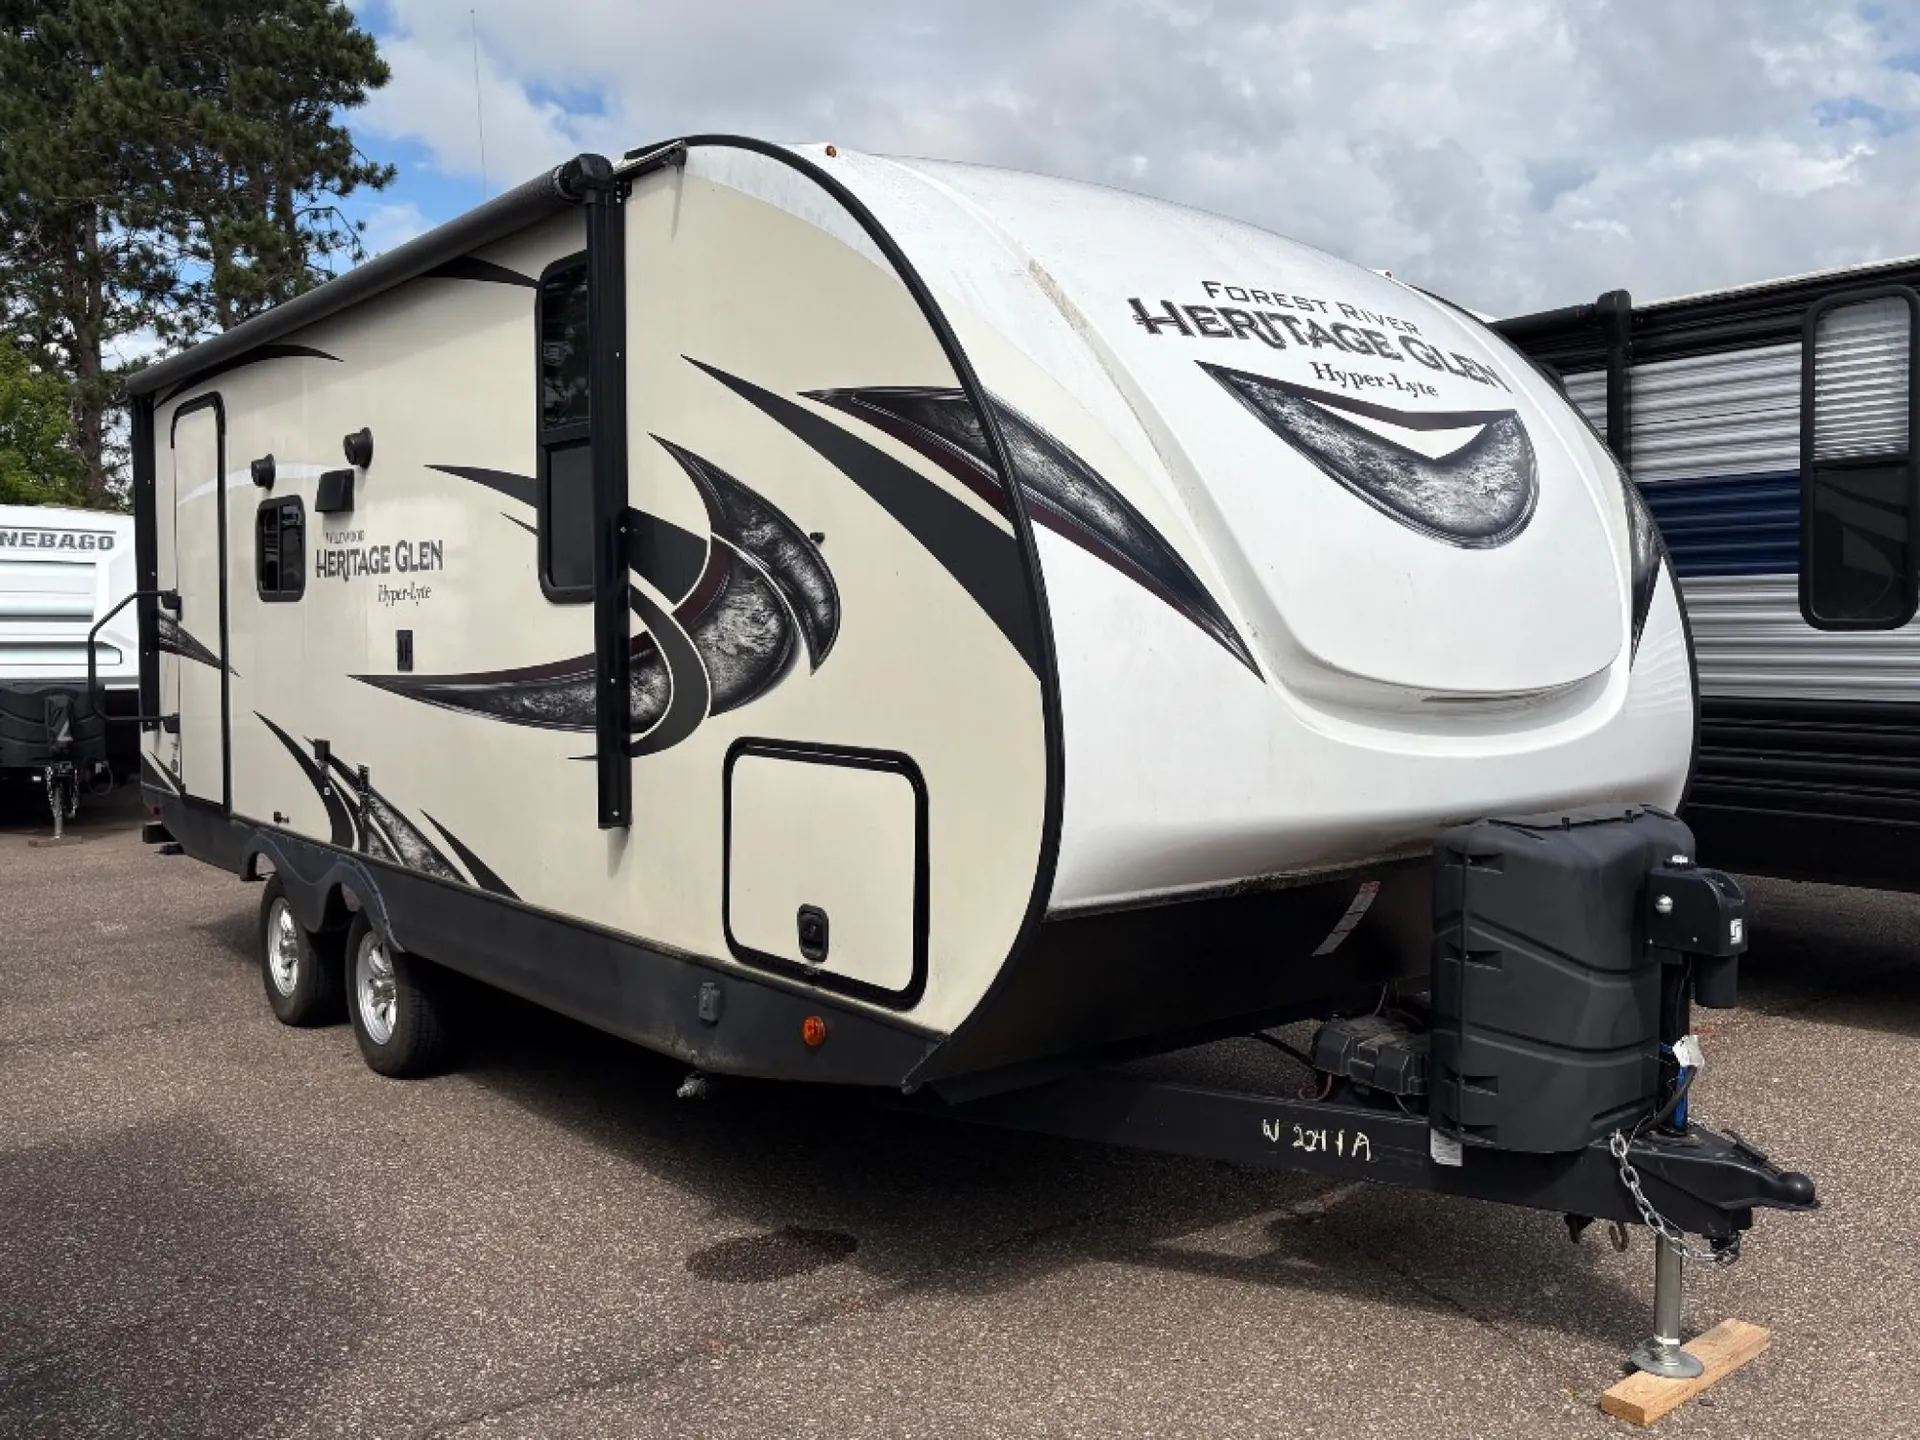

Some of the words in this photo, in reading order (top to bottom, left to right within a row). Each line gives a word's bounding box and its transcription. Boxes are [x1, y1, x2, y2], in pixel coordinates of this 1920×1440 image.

[1201, 281, 1328, 314] FOREST
[1335, 301, 1423, 336] RIVER
[1127, 298, 1404, 362] HERITAGE
[1399, 335, 1513, 394] GLEN
[1308, 361, 1438, 398] Hyper-Lyte
[316, 545, 390, 583] HERITAGE
[395, 539, 443, 573] GLEN
[377, 581, 431, 607] Hyper-Lyte
